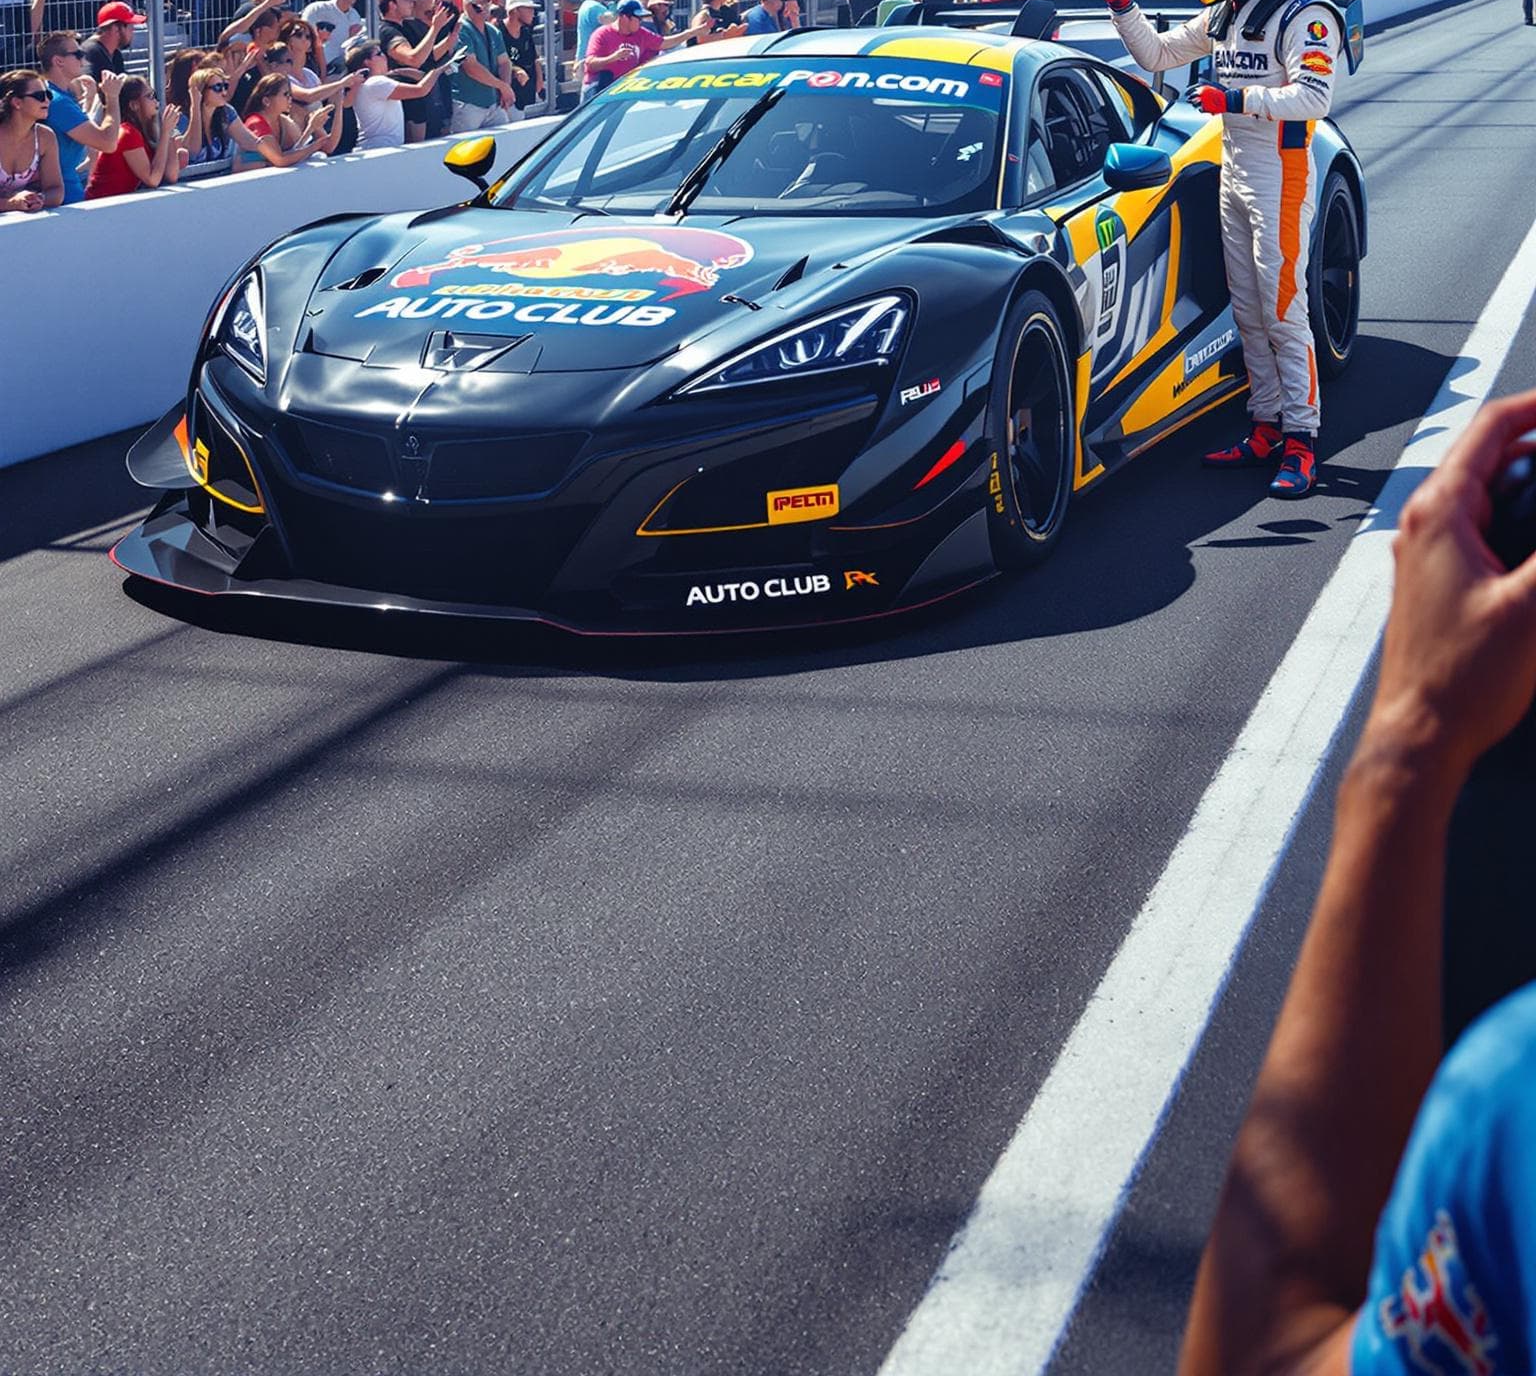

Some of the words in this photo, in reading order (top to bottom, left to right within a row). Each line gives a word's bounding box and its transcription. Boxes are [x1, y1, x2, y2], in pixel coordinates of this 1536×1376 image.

[354, 296, 515, 320] AUTO
[514, 302, 677, 326] CLUB
[686, 581, 760, 606] AUTO
[763, 574, 831, 598] CLUB
